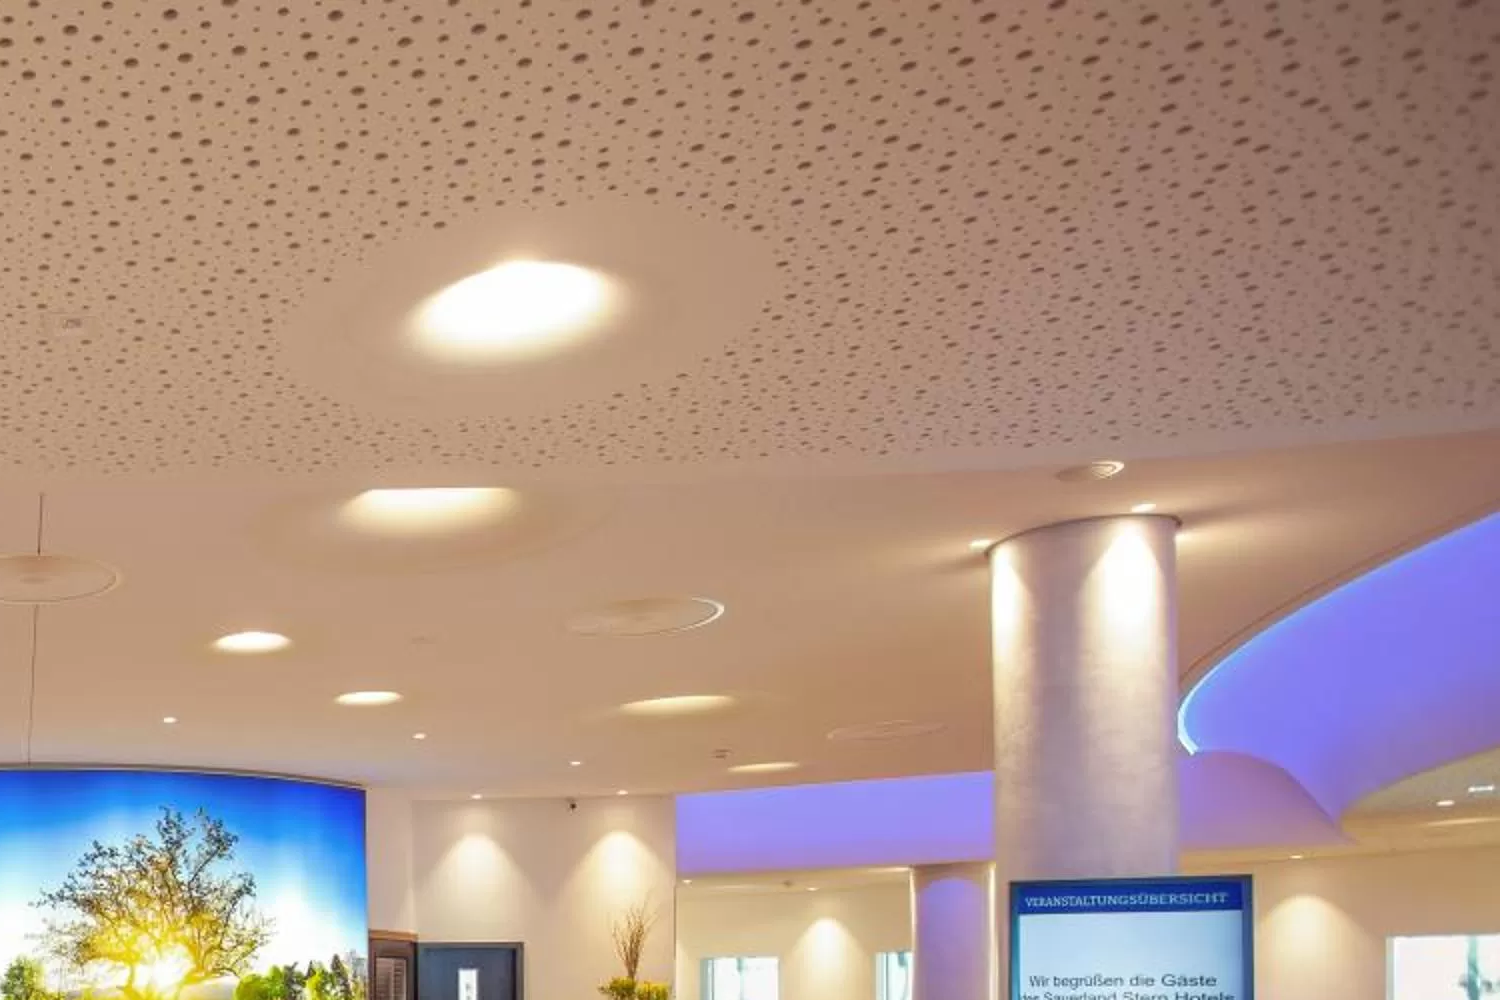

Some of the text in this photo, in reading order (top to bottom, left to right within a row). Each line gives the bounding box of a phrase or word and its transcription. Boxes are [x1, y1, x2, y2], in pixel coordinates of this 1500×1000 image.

[1025, 891, 1228, 907] VERANSTALTUNGSÜBERSICHT
[1029, 973, 1217, 990] Wir begrüßen die Gäste
